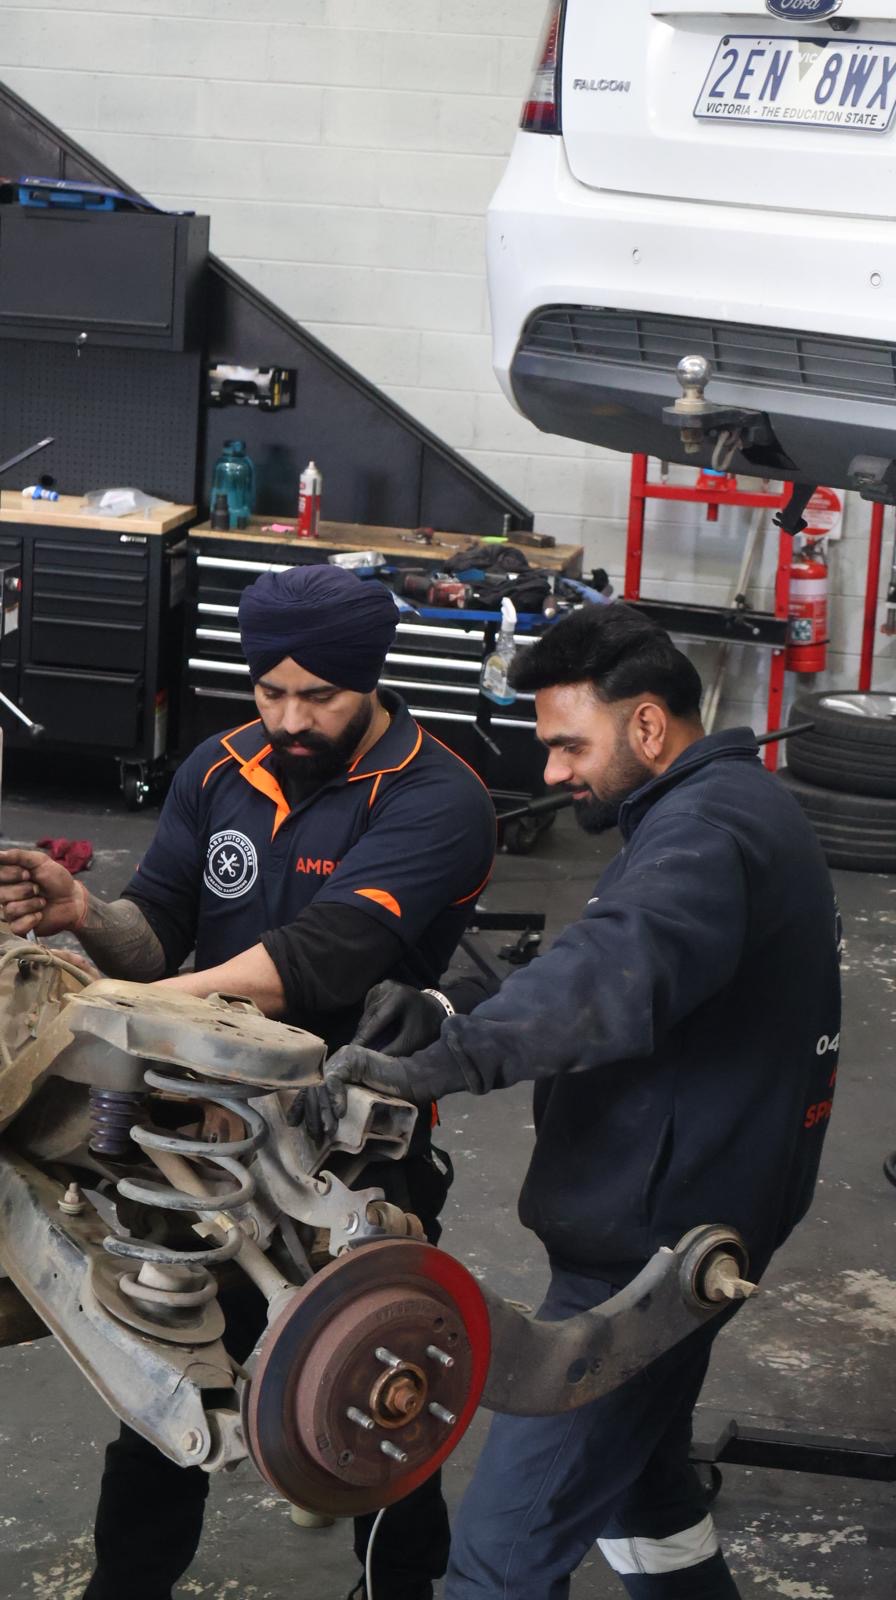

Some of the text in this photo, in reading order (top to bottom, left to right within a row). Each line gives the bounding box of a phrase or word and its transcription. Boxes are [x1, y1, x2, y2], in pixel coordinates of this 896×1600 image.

[573, 79, 631, 92] FALCON
[708, 48, 896, 110] 2EN 8WX
[706, 102, 751, 116] VICTORIA
[761, 106, 780, 118] THE
[783, 107, 842, 122] EDUCATION
[844, 112, 878, 125] STATE
[223, 835, 253, 866] AUTOWORKS
